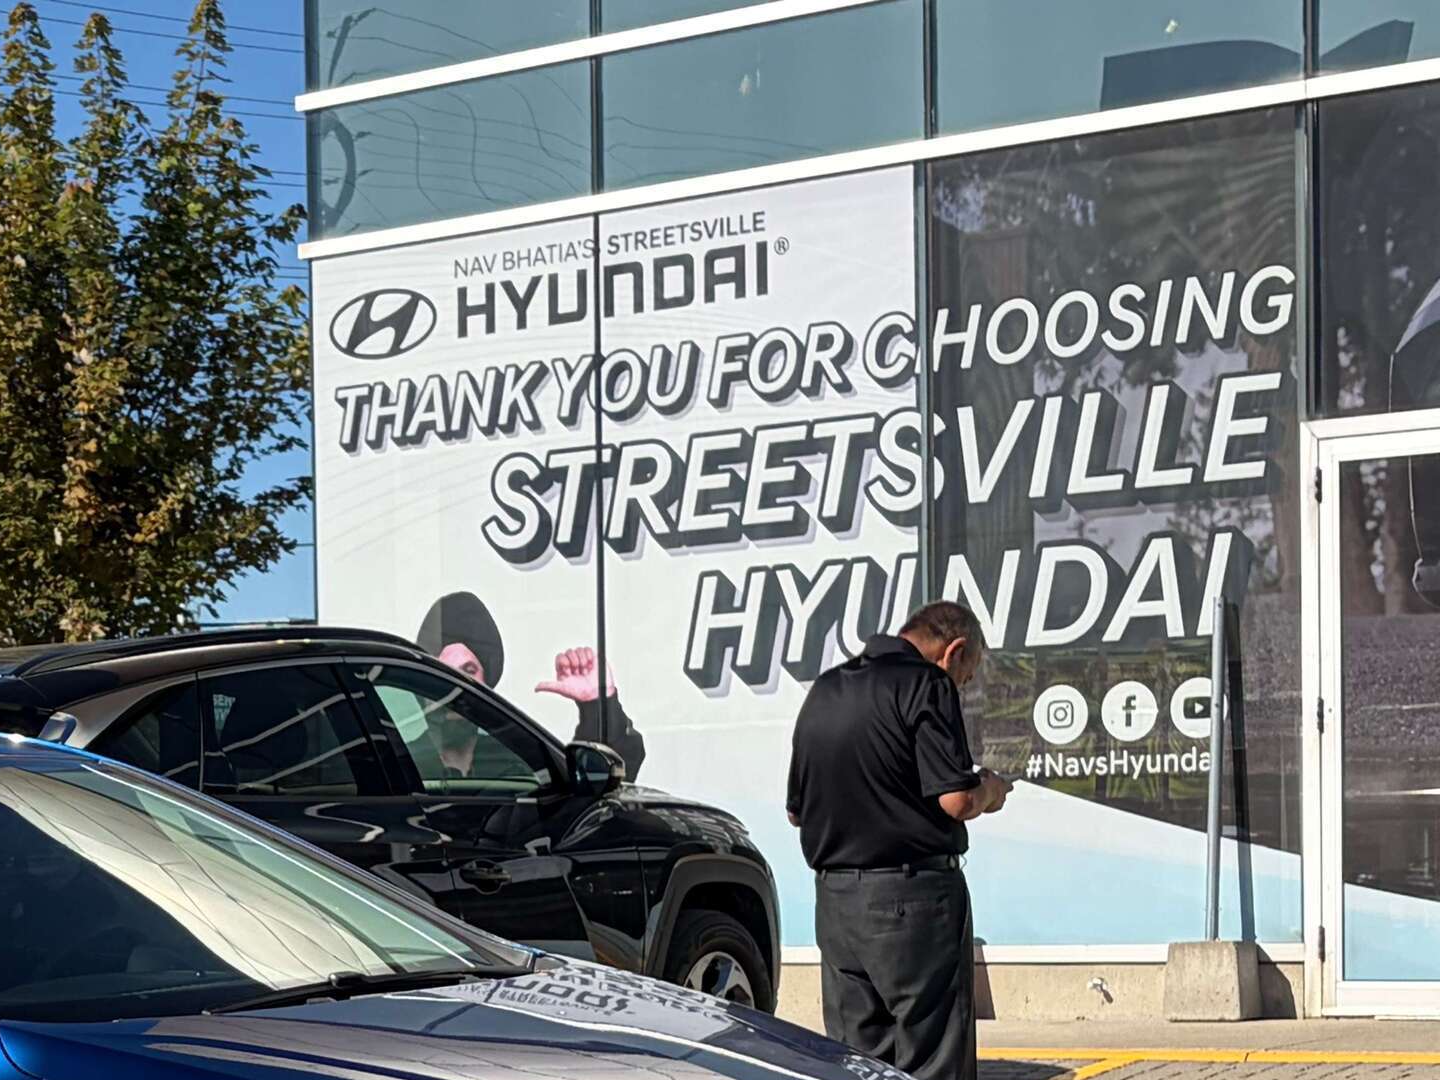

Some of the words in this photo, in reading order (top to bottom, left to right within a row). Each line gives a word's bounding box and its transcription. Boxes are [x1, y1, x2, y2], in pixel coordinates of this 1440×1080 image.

[453, 254, 498, 279] NAV
[502, 238, 597, 271] BHATIA'S
[606, 210, 766, 255] STREETSVILLE
[334, 360, 551, 455] THANK
[551, 340, 703, 430] YOU
[706, 320, 861, 402] FOR
[863, 264, 1297, 388] CHOOSING
[480, 370, 1284, 566] STREETSVILLE
[1026, 746, 1211, 780] #NavsHyunda
